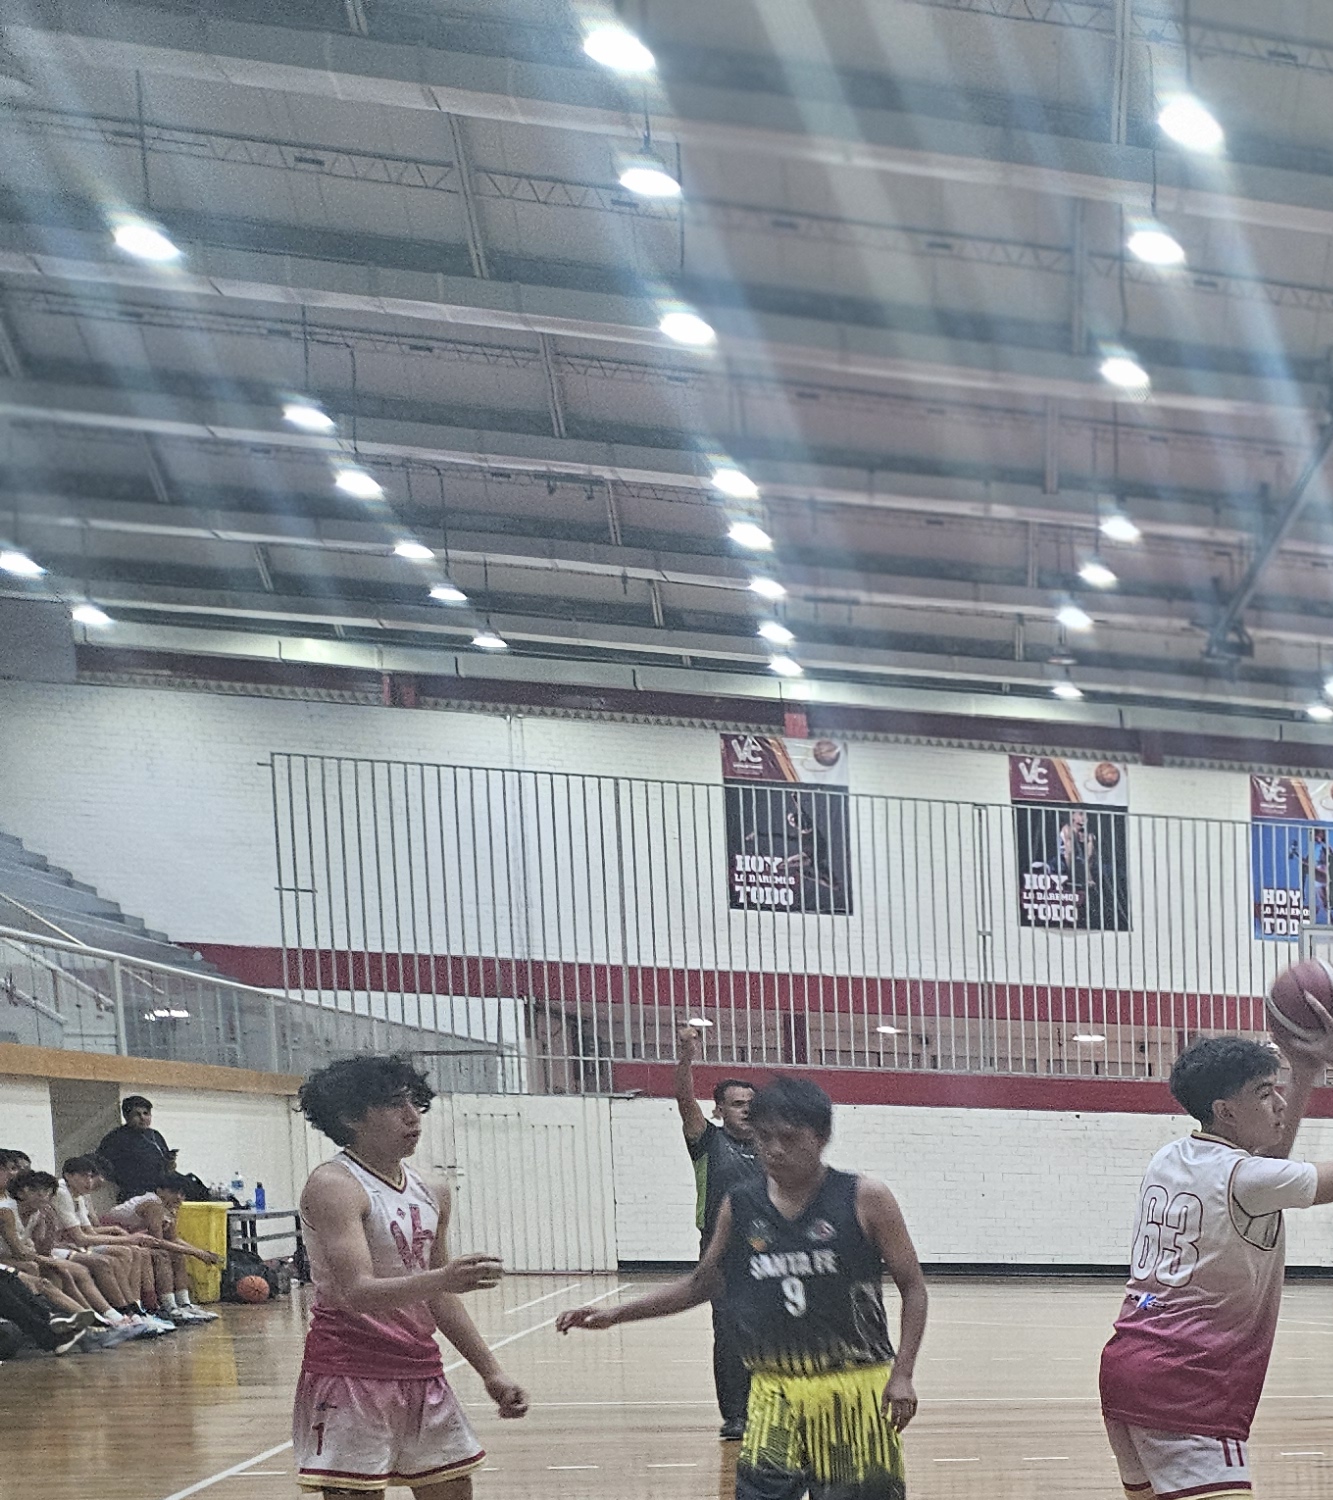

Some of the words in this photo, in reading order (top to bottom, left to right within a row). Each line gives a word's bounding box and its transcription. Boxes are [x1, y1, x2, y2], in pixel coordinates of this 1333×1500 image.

[735, 854, 784, 873] HOY
[1023, 873, 1069, 891] HOY
[735, 885, 794, 906] TODO
[1263, 888, 1301, 907] HOY
[1023, 903, 1079, 922] TODO
[1263, 917, 1310, 935] TOD
[1131, 1185, 1203, 1288] 63
[782, 1277, 807, 1317] 9
